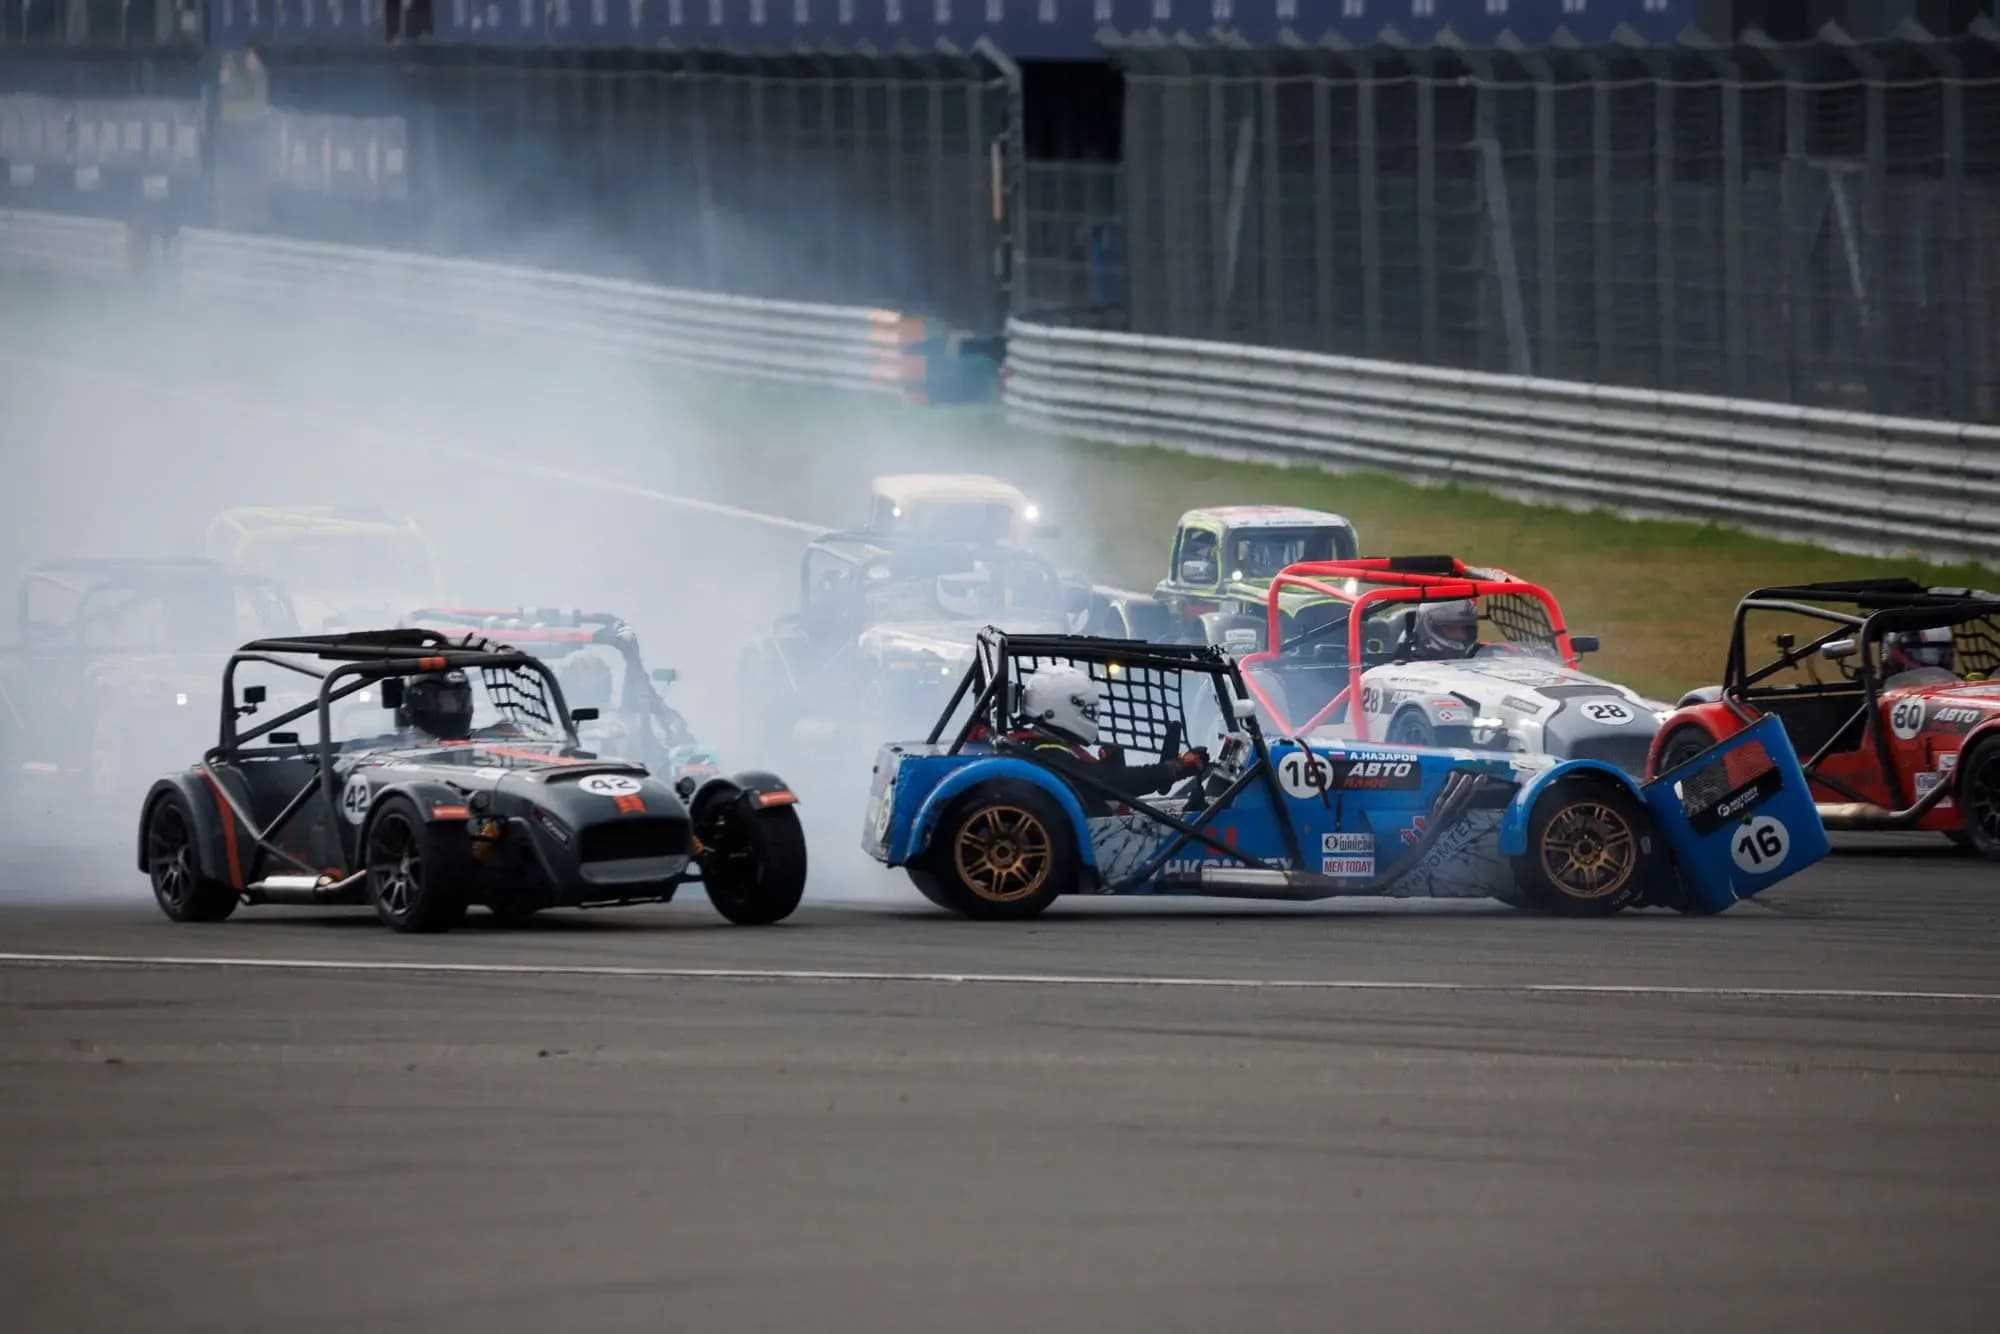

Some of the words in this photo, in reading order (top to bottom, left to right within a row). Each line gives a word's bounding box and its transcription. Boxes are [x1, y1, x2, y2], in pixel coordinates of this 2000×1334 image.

[1362, 688, 1378, 712] 28
[1587, 704, 1627, 719] 28
[1894, 705, 1921, 730] 80
[1933, 708, 1980, 723] АВТО
[1349, 752, 1418, 761] А.НАЗАРОВ
[1284, 761, 1327, 787] 16
[1347, 762, 1412, 777] АВТО
[592, 779, 637, 790] 42
[346, 785, 369, 812] 42
[1738, 825, 1782, 865] 16
[1324, 861, 1344, 873] MEN
[1345, 861, 1373, 873] TODAY
